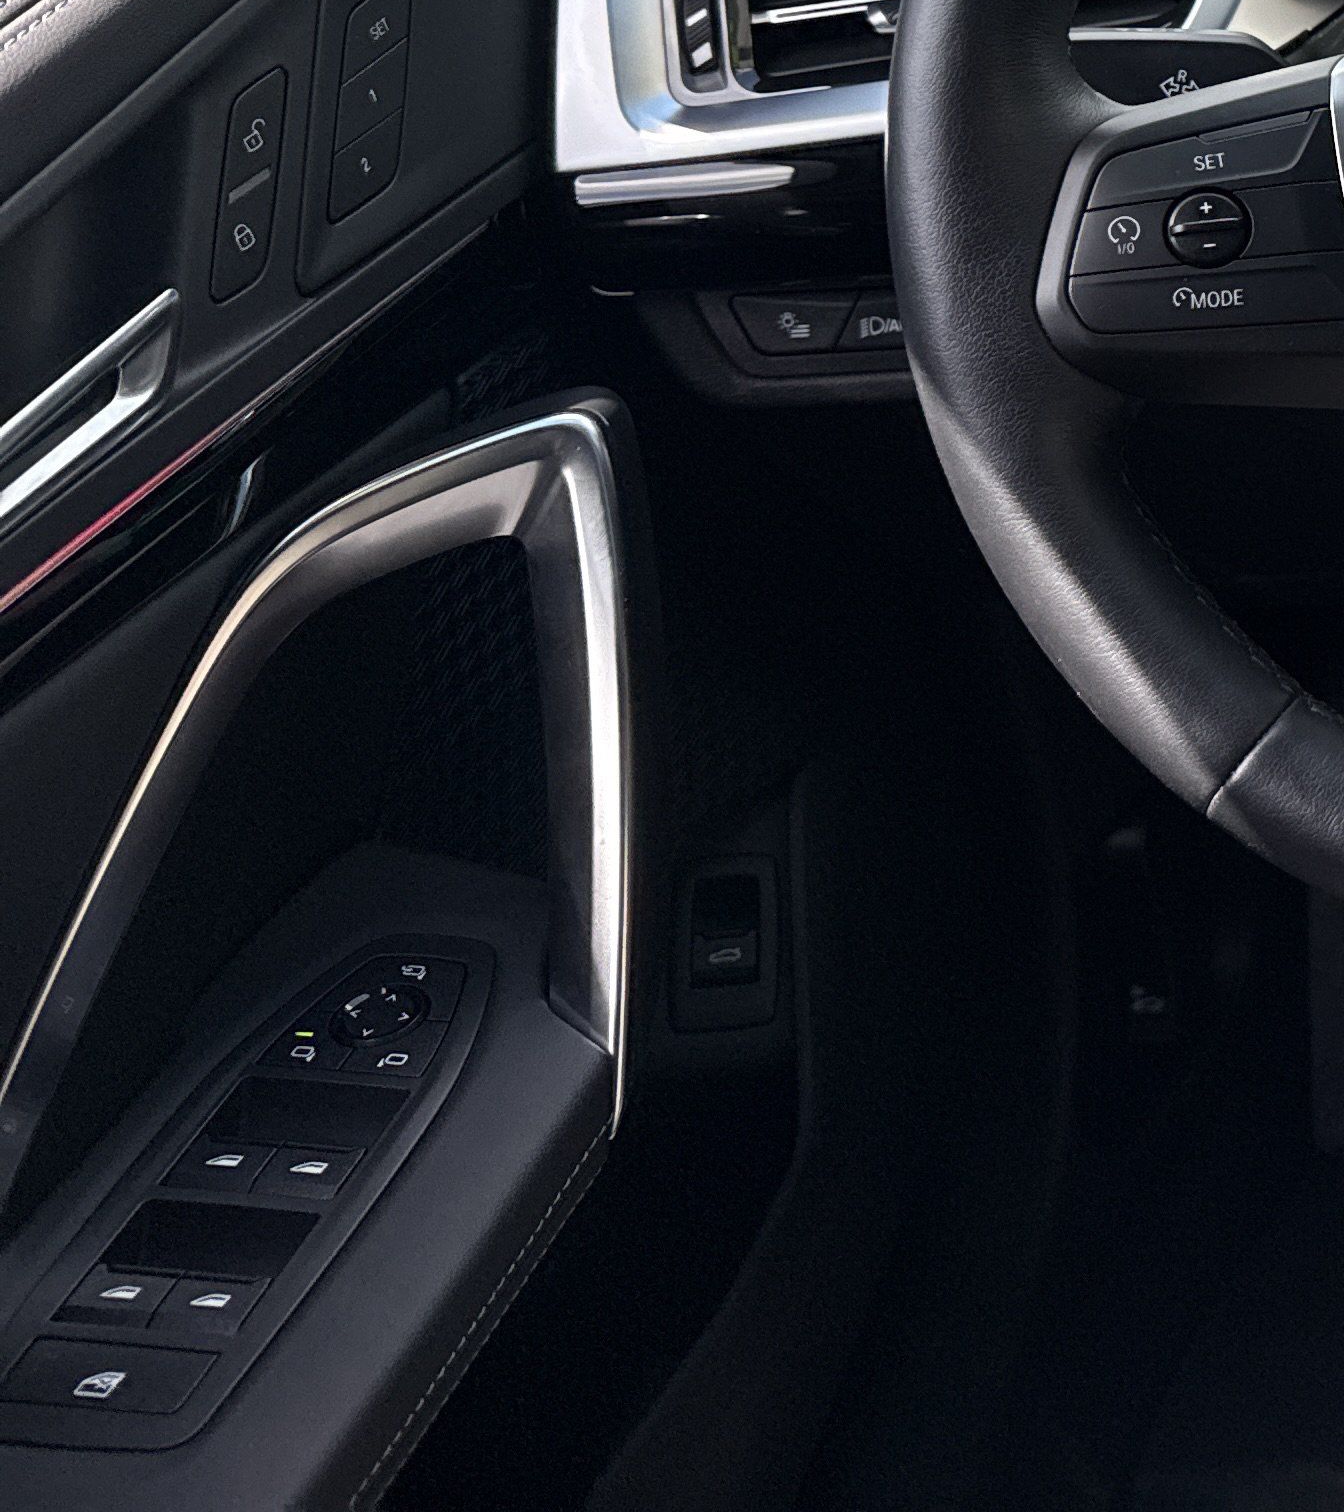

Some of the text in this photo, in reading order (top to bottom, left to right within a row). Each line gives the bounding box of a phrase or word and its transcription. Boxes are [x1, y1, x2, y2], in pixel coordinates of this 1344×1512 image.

[369, 16, 391, 41] SET
[1176, 69, 1188, 82] R
[368, 88, 378, 102] 1
[360, 156, 372, 173] 2
[1193, 152, 1225, 171] SET
[1191, 288, 1245, 310] MODE
